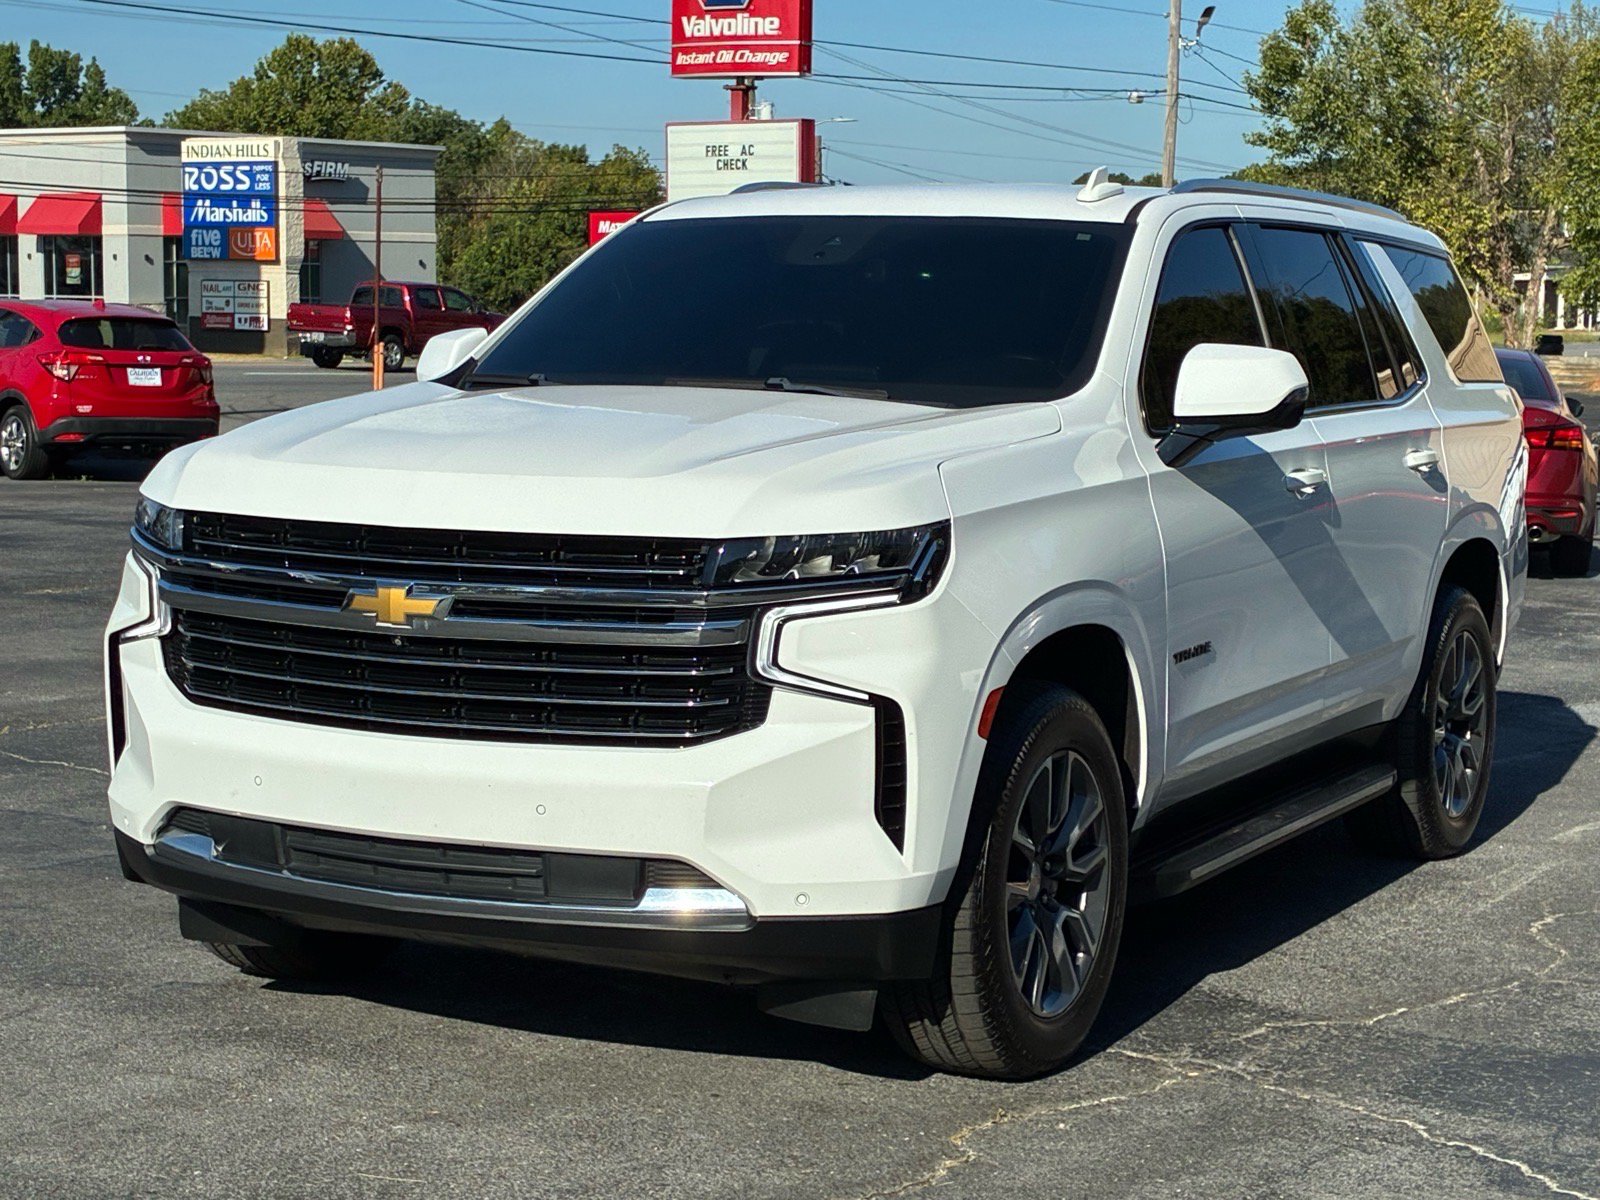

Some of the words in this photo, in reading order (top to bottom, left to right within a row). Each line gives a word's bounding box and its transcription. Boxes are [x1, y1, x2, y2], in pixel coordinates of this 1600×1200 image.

[681, 13, 781, 38] Valvoline
[676, 51, 715, 65] Instant
[715, 50, 734, 64] Oil
[735, 50, 789, 65] Change
[186, 144, 232, 158] INDIAN
[236, 143, 269, 157] HILLS
[705, 145, 729, 157] FREE
[740, 144, 755, 156] AC
[716, 159, 748, 171] CHECK
[184, 165, 251, 191] ROSS
[190, 199, 269, 222] Marshalls
[191, 229, 221, 246] five
[237, 231, 272, 248] ULTA
[191, 247, 221, 259] BELOW
[202, 283, 222, 293] NAIL
[237, 283, 265, 291] GNC
